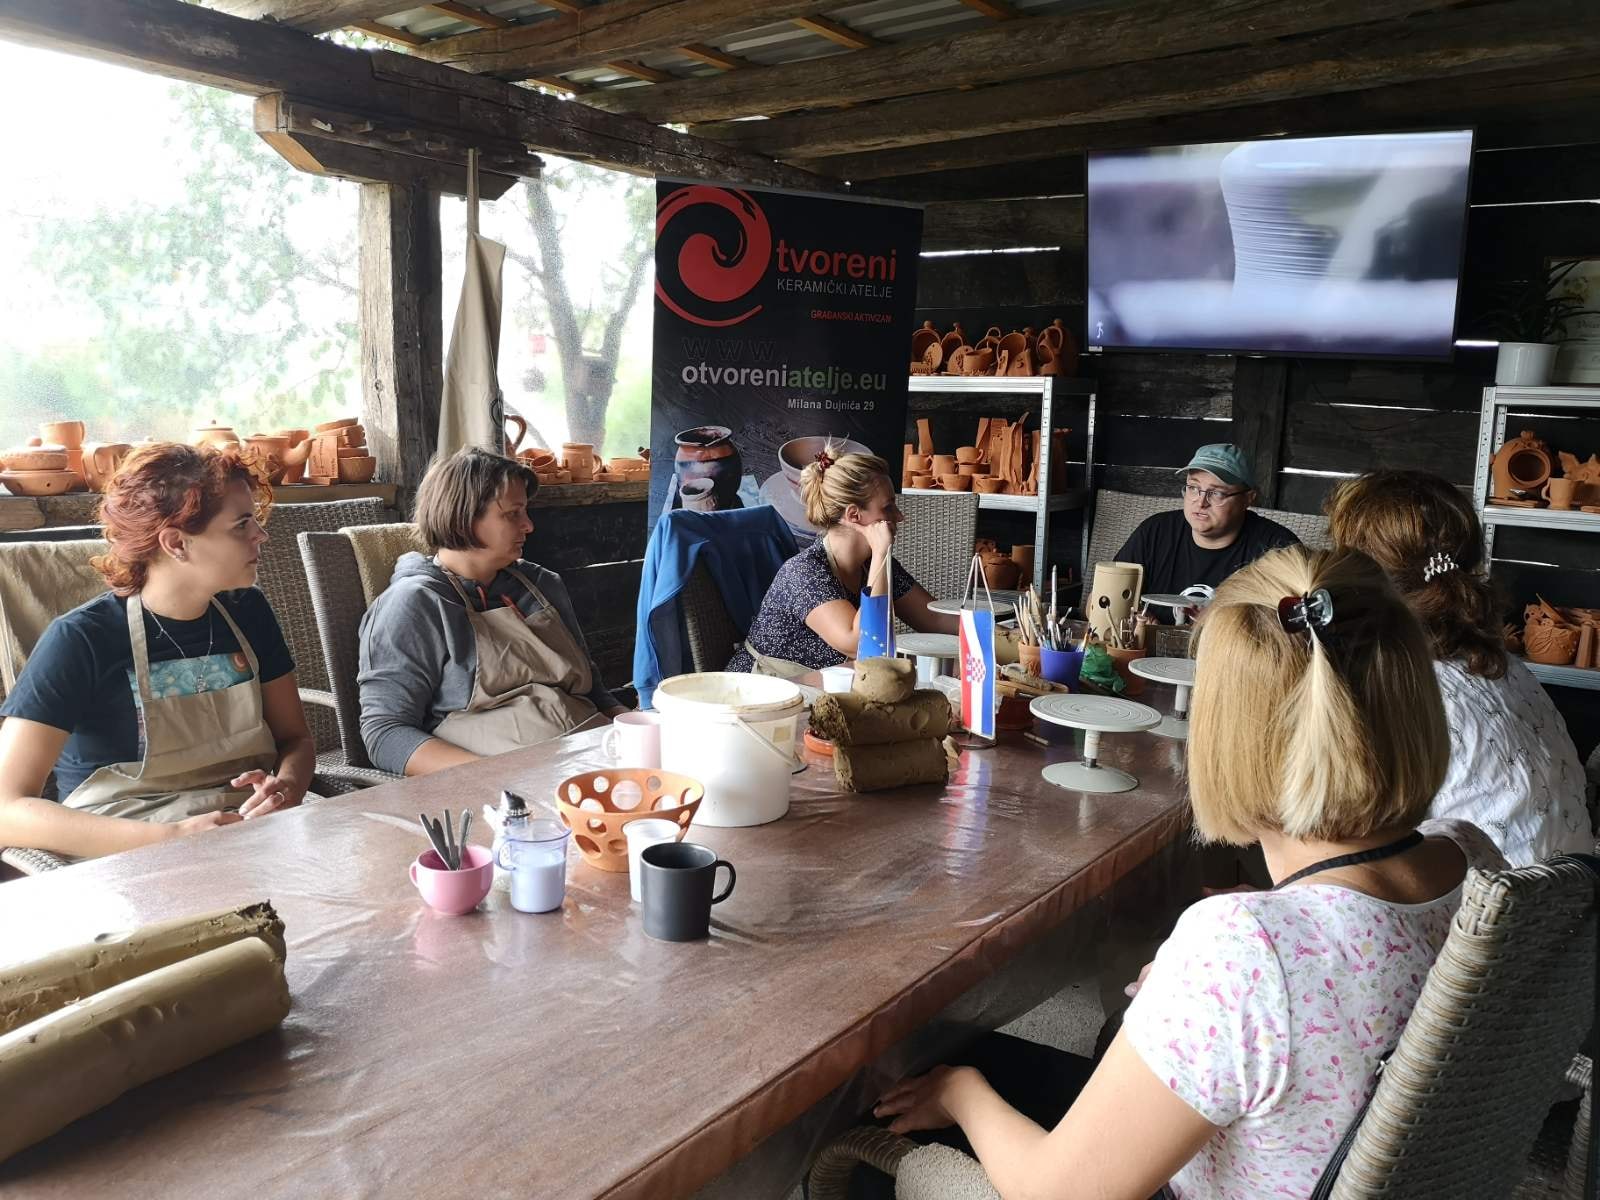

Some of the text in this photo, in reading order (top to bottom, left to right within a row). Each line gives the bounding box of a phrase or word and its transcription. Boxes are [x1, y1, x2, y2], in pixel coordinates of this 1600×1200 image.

[777, 278, 893, 298] KERAMIČKI ATELJE
[681, 361, 887, 394] otvoreniatelje.eu
[787, 398, 822, 409] Milana
[863, 401, 875, 411] 29
